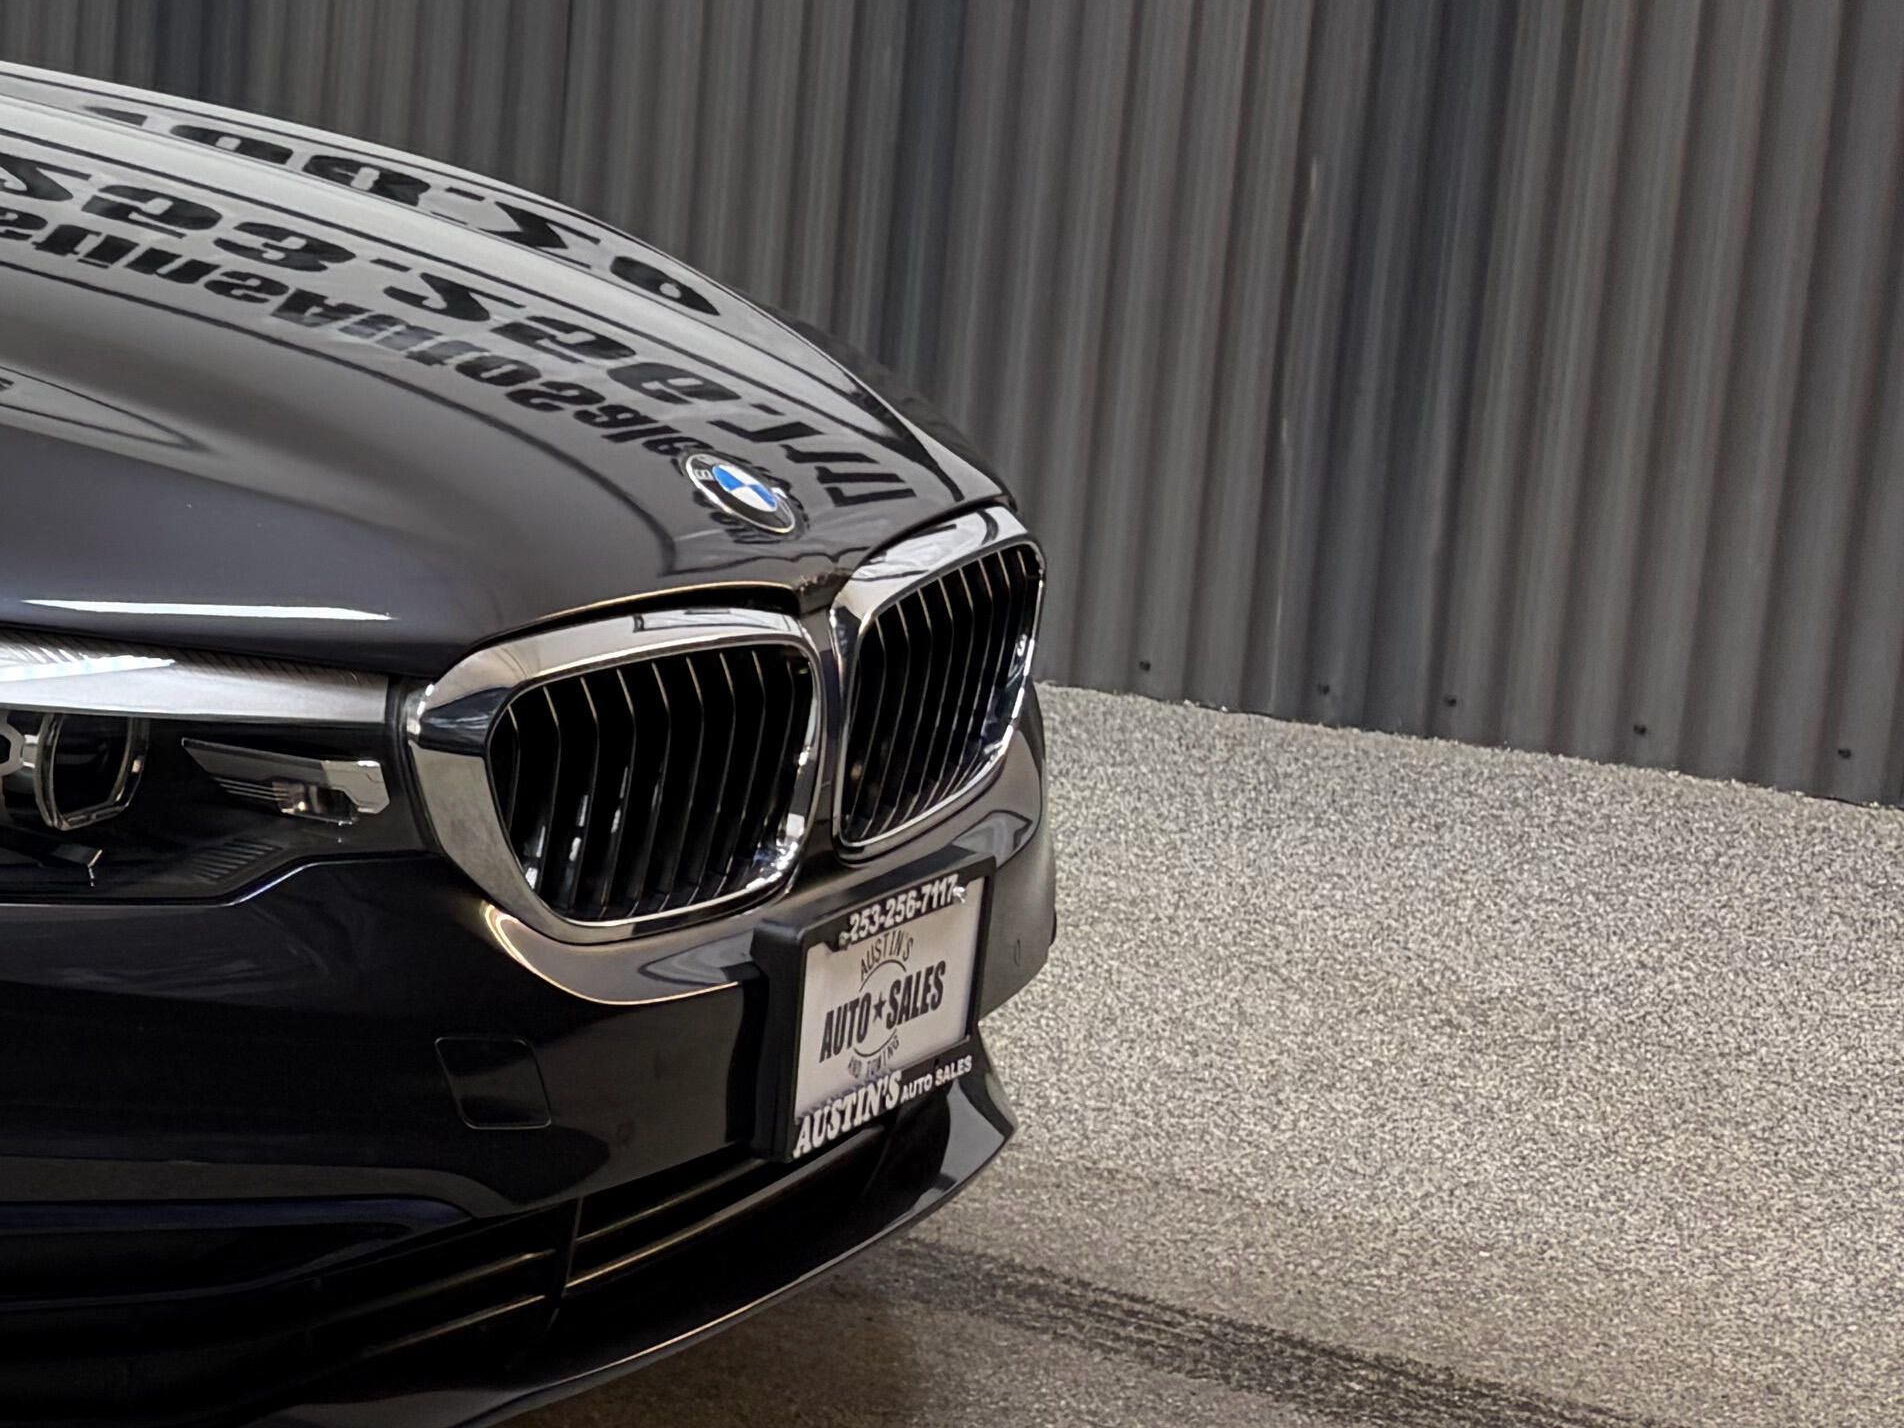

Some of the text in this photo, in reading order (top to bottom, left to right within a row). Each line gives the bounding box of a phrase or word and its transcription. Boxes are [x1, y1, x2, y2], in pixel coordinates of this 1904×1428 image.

[849, 873, 959, 943] 253-256-7117
[859, 928, 915, 980] AUSTIN'S
[819, 960, 946, 1063] AUTO SALES
[793, 1054, 973, 1159] AUSTIN'S AUTO SALES
